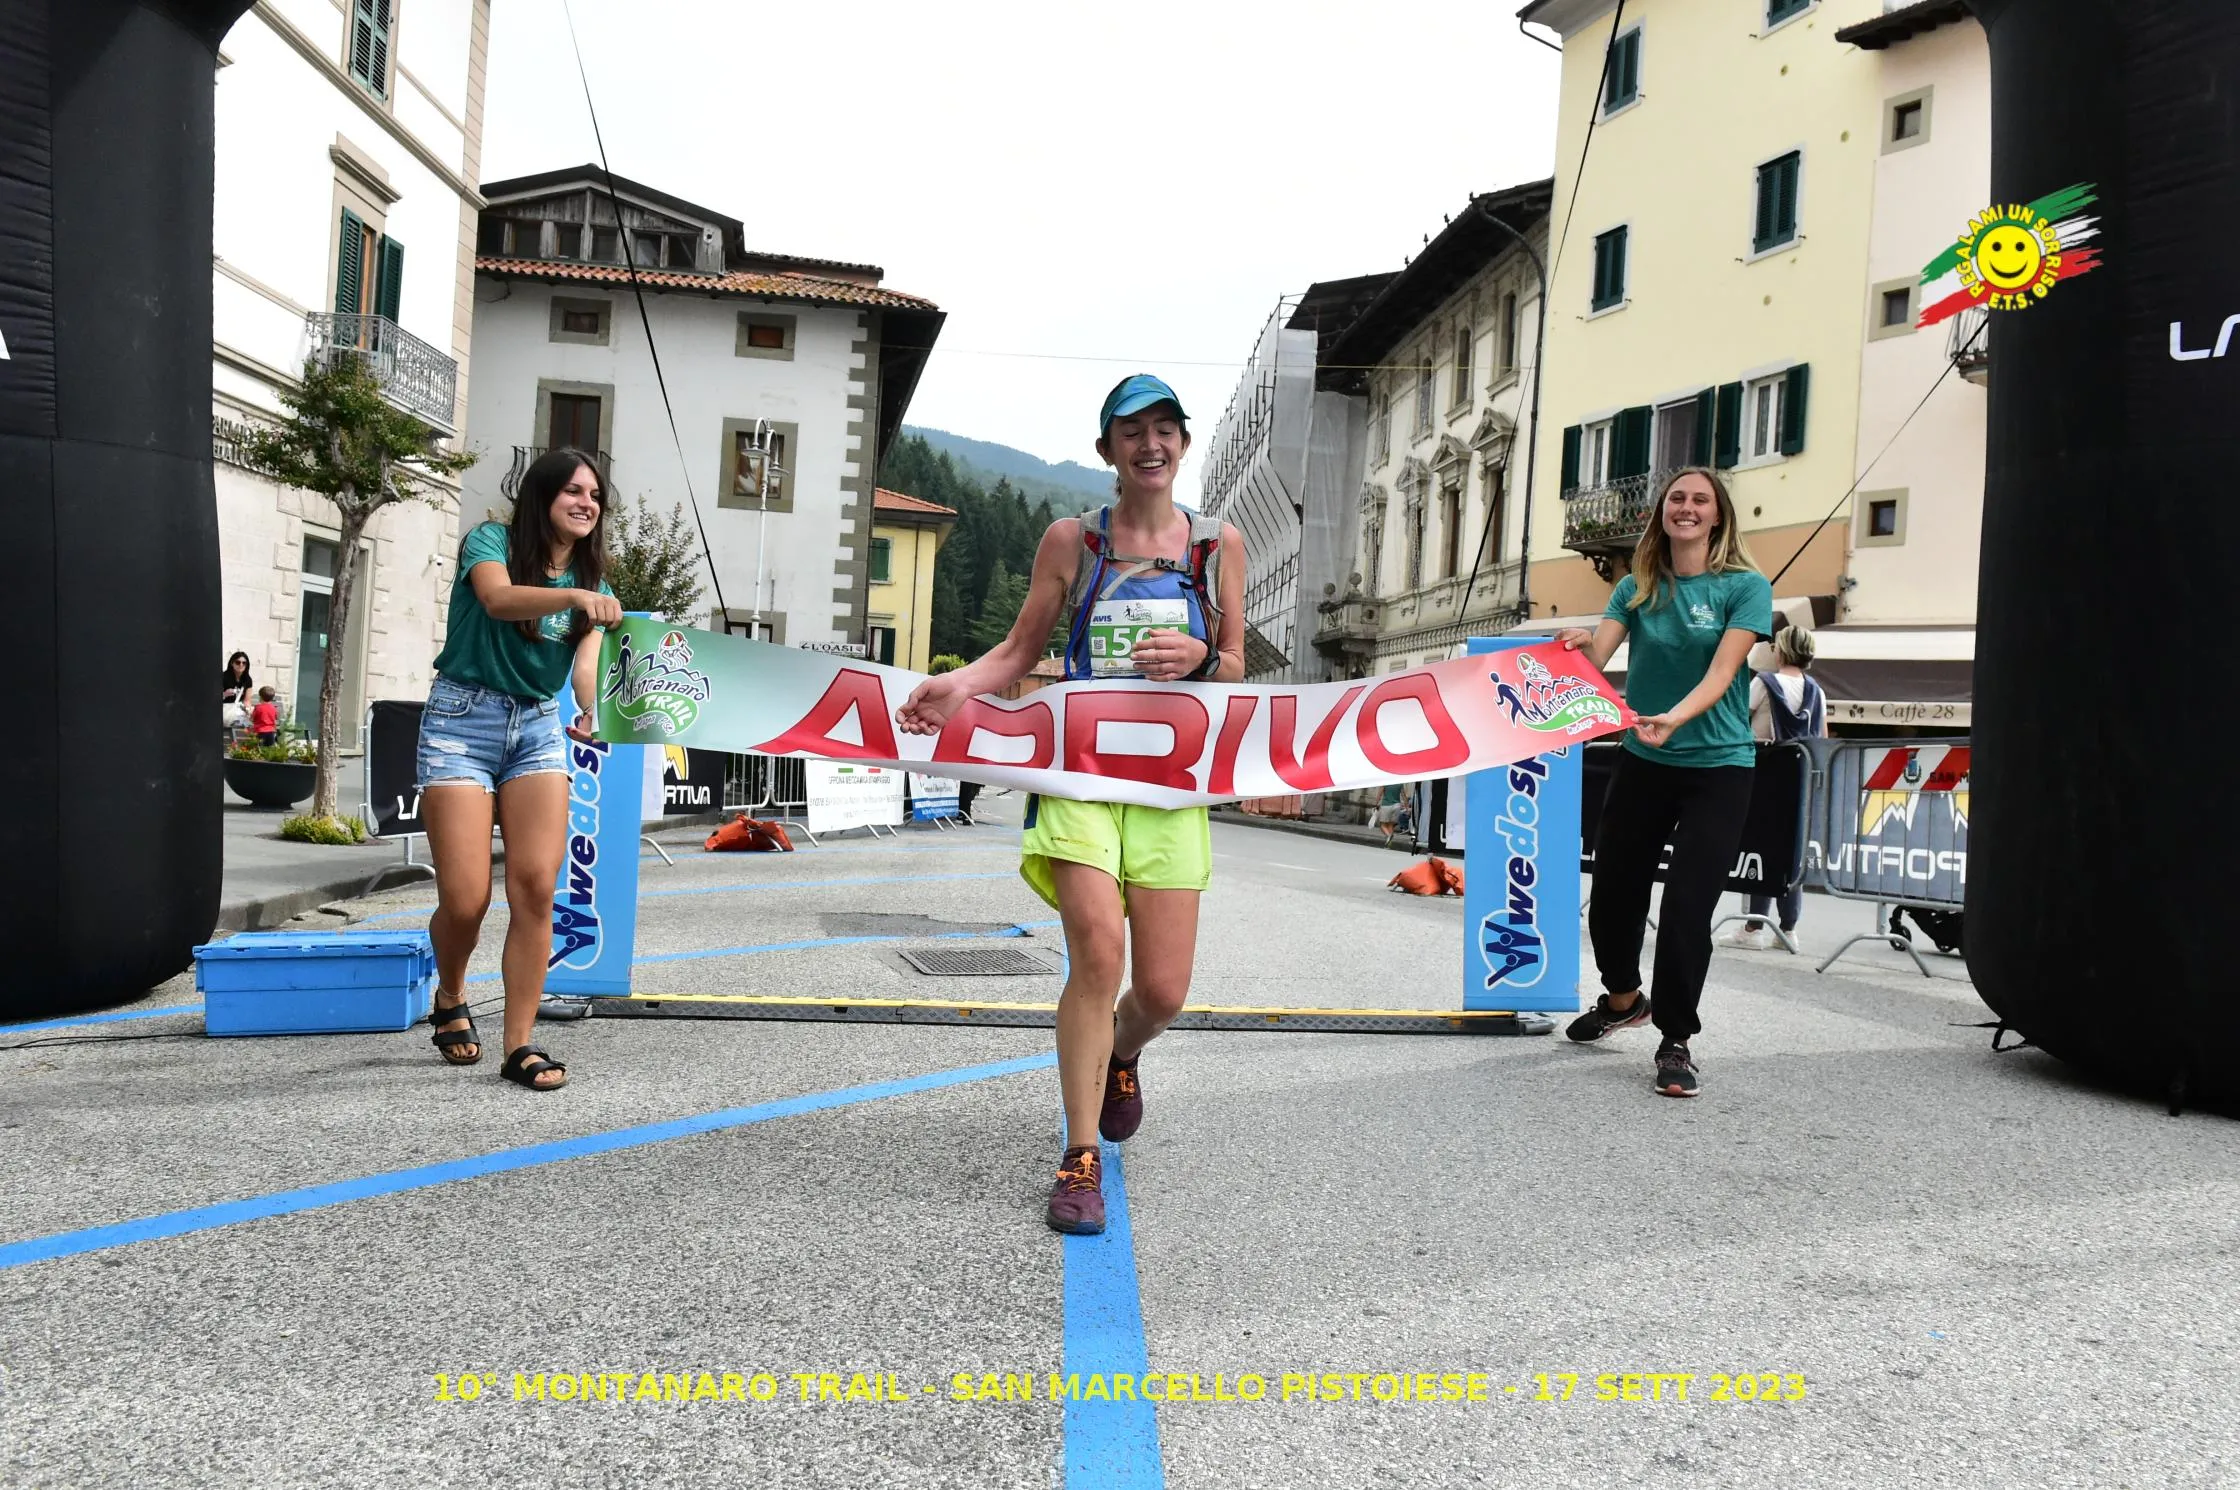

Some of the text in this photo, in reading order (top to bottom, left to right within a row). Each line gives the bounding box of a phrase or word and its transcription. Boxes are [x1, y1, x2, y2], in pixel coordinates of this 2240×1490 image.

[811, 643, 853, 652] L'OASI
[645, 695, 692, 726] TRAIL
[1527, 686, 1596, 721] Montanaro
[1566, 700, 1615, 719] TRAIL
[1880, 703, 1955, 722] Caffè 28
[747, 667, 1470, 795] ARRIVO
[1930, 771, 1955, 783] SAN
[664, 785, 710, 805] RTIVA
